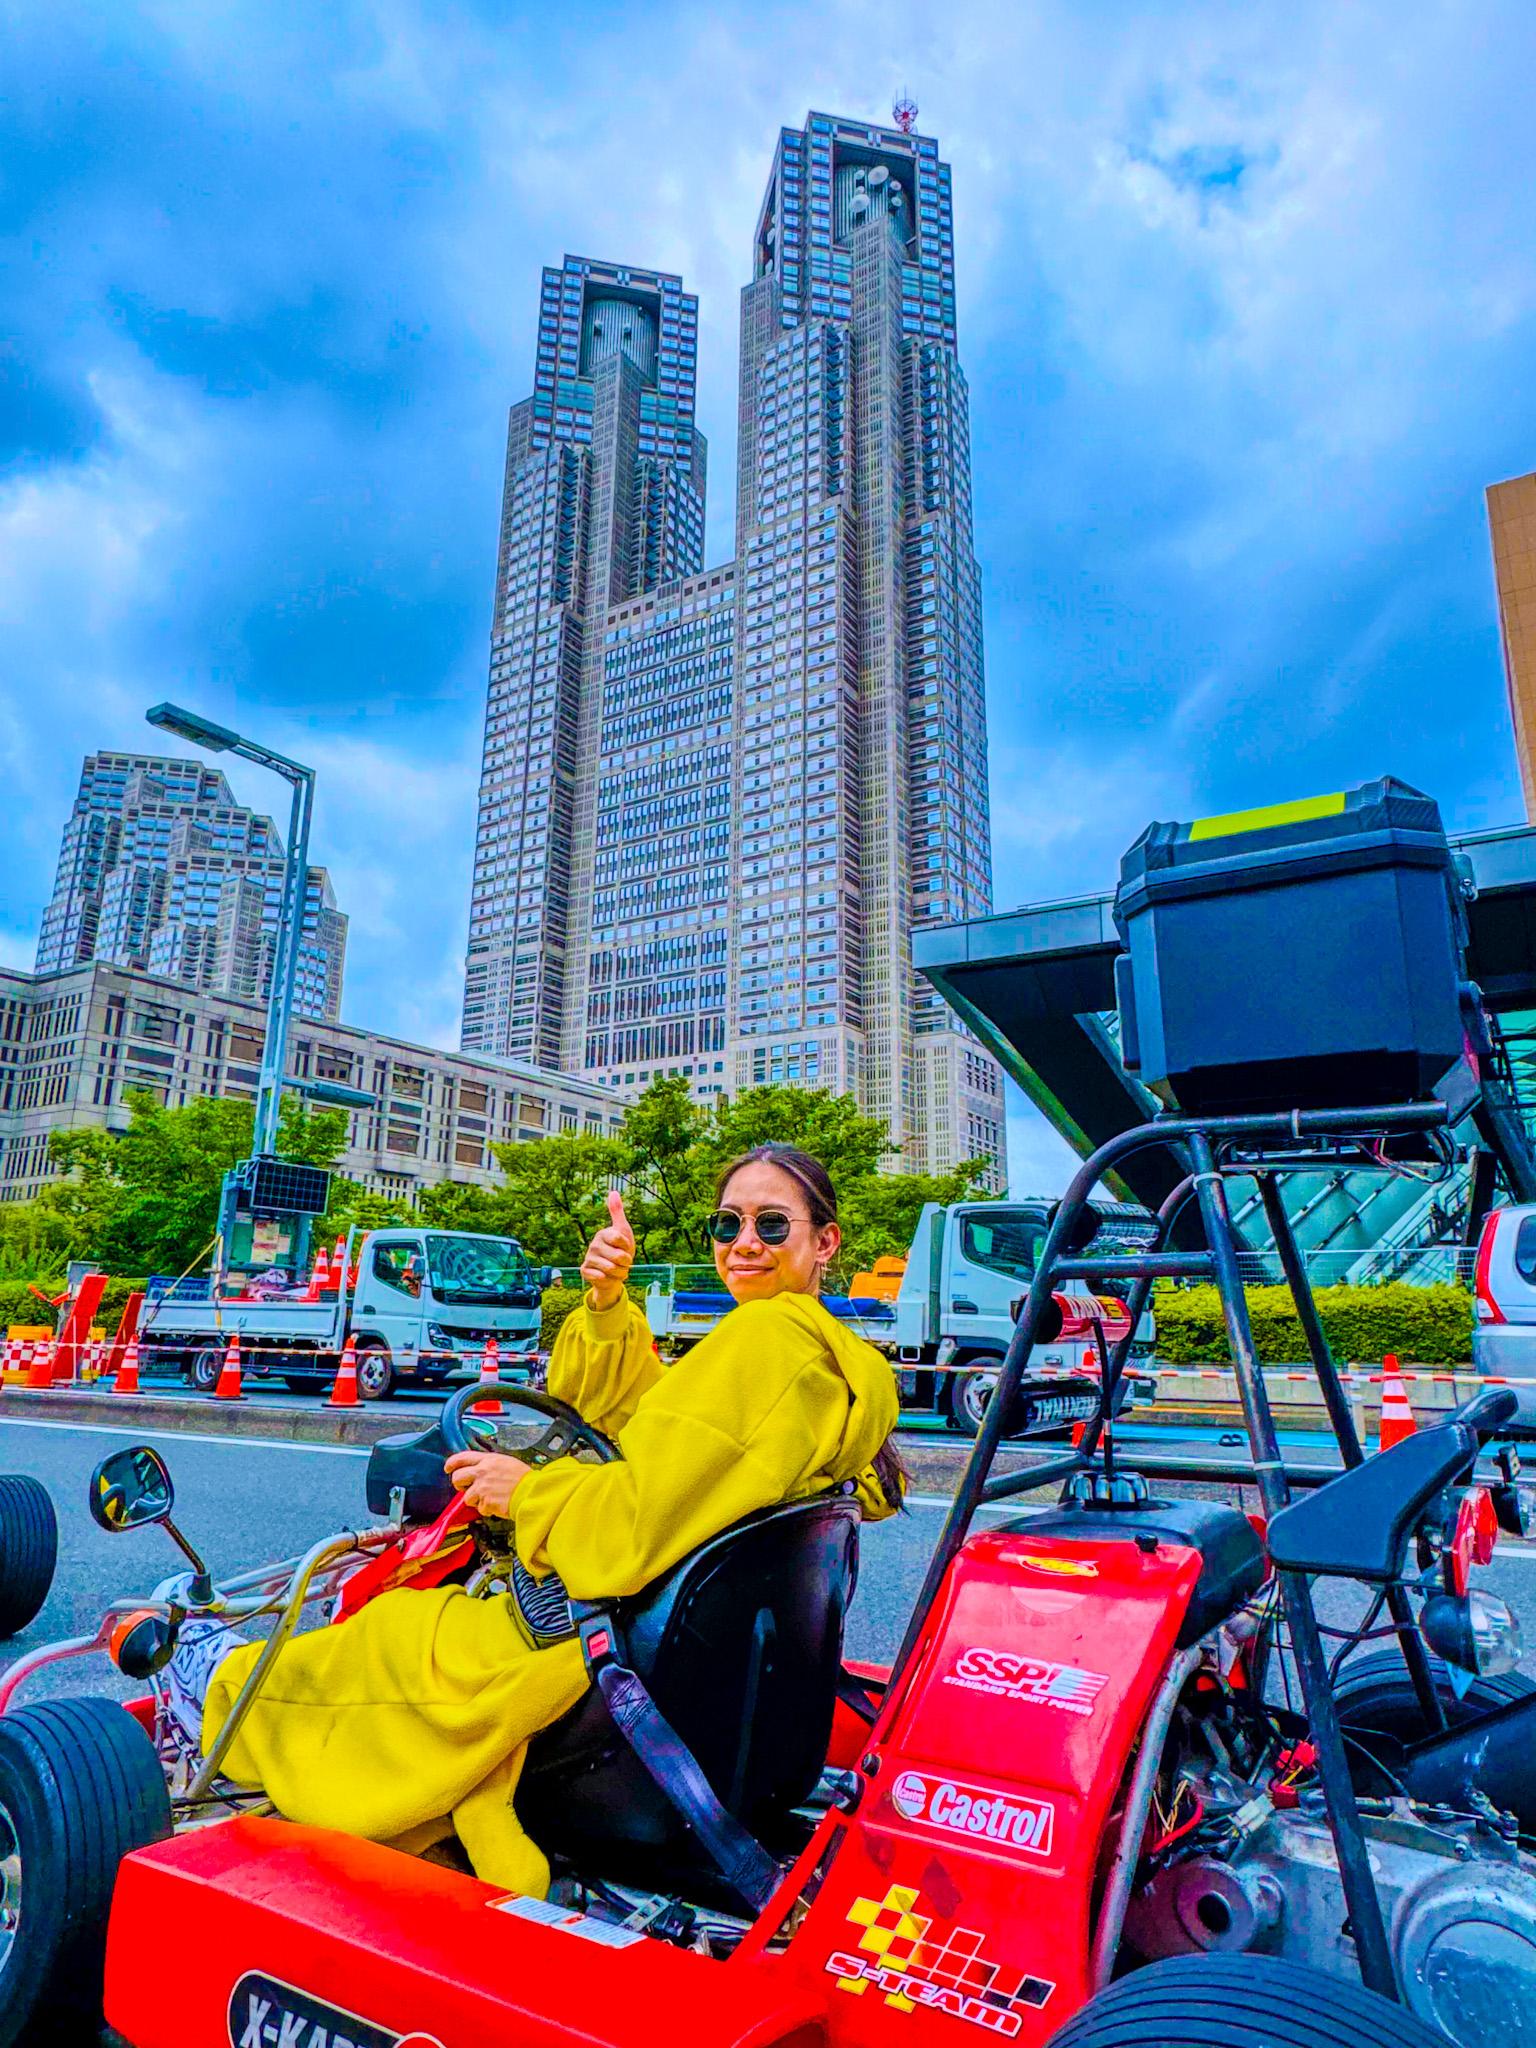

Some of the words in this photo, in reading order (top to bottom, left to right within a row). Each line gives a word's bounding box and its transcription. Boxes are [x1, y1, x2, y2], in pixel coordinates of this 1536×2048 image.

[942, 1676, 1006, 1695] STANDARD
[1007, 1690, 1048, 1704] SPORT
[929, 1783, 1050, 1847] Castrol
